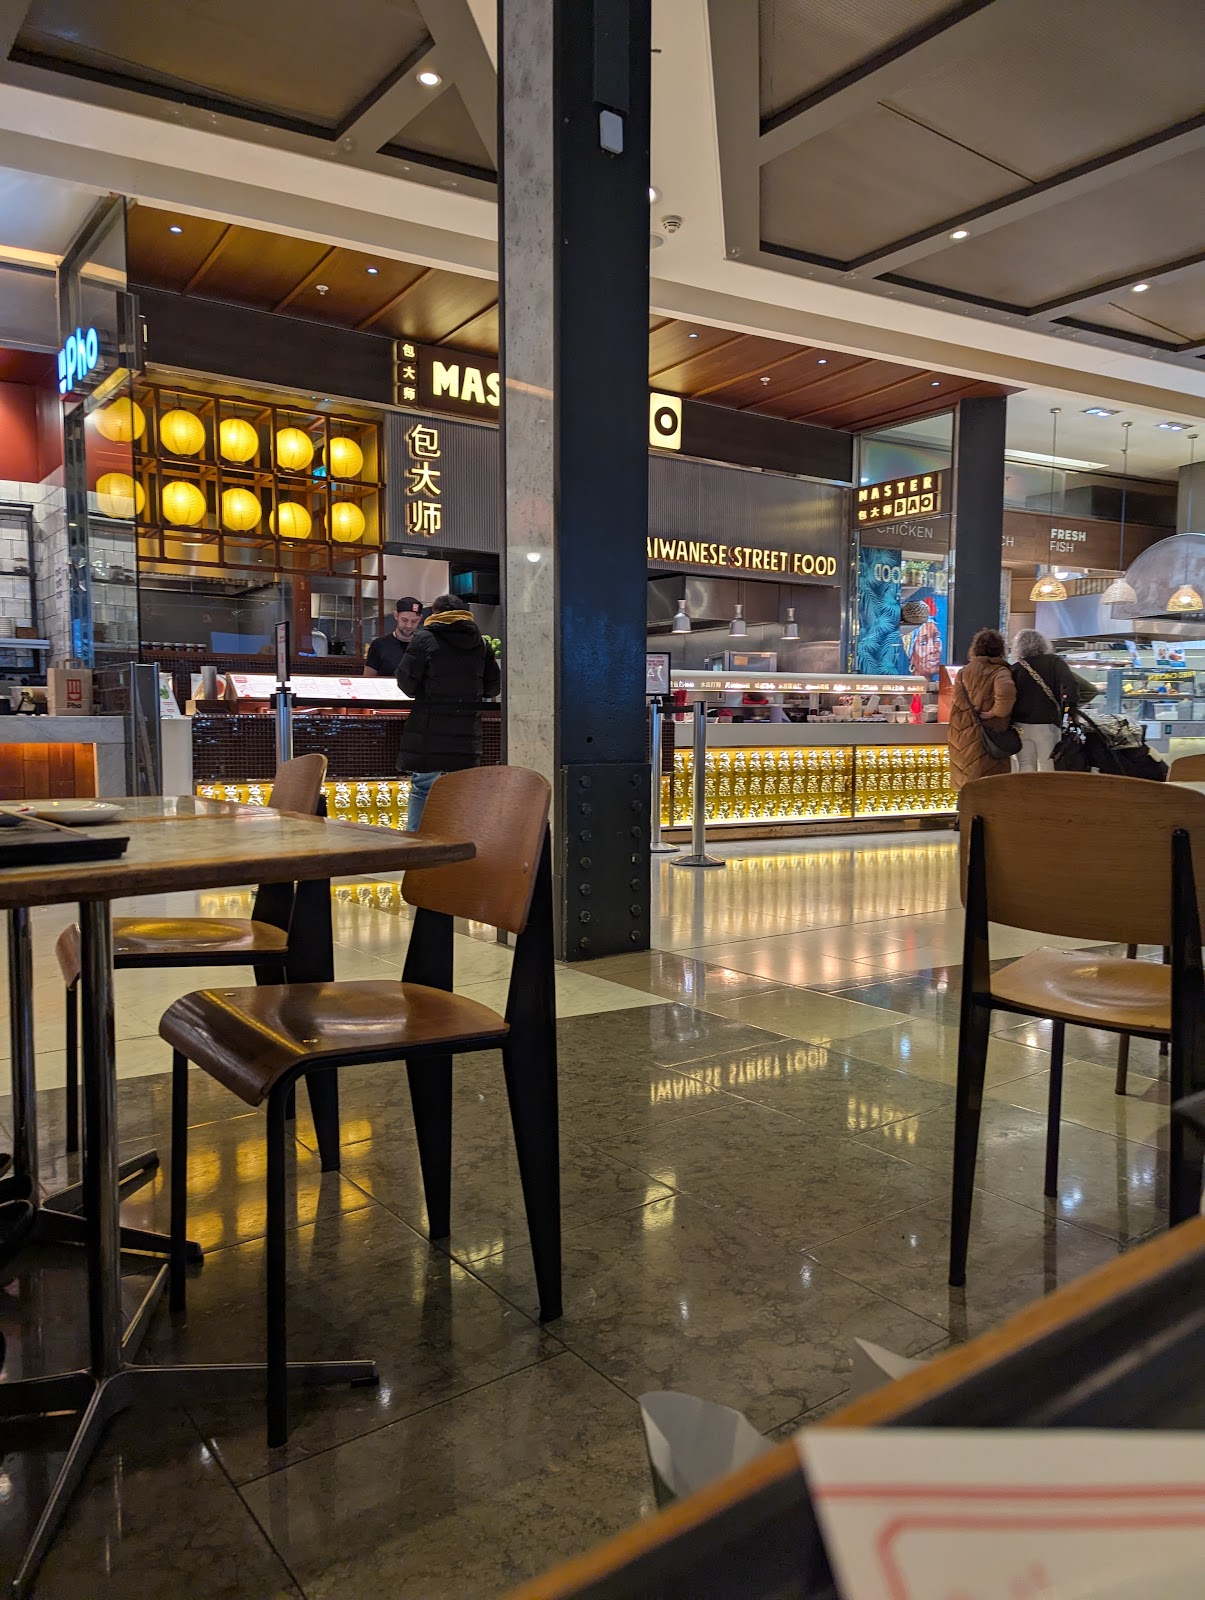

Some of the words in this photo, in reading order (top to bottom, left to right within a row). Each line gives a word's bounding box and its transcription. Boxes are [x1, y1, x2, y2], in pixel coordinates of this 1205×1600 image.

[402, 343, 416, 401] 包大师
[411, 423, 442, 534] 包大师
[858, 476, 932, 502] MASTER
[895, 496, 932, 514] BAO
[876, 524, 933, 539] CHICKEN
[1050, 528, 1087, 542] FRESH
[1049, 540, 1075, 553] FISH
[734, 546, 788, 572] STREET
[793, 553, 837, 576] FOOD
